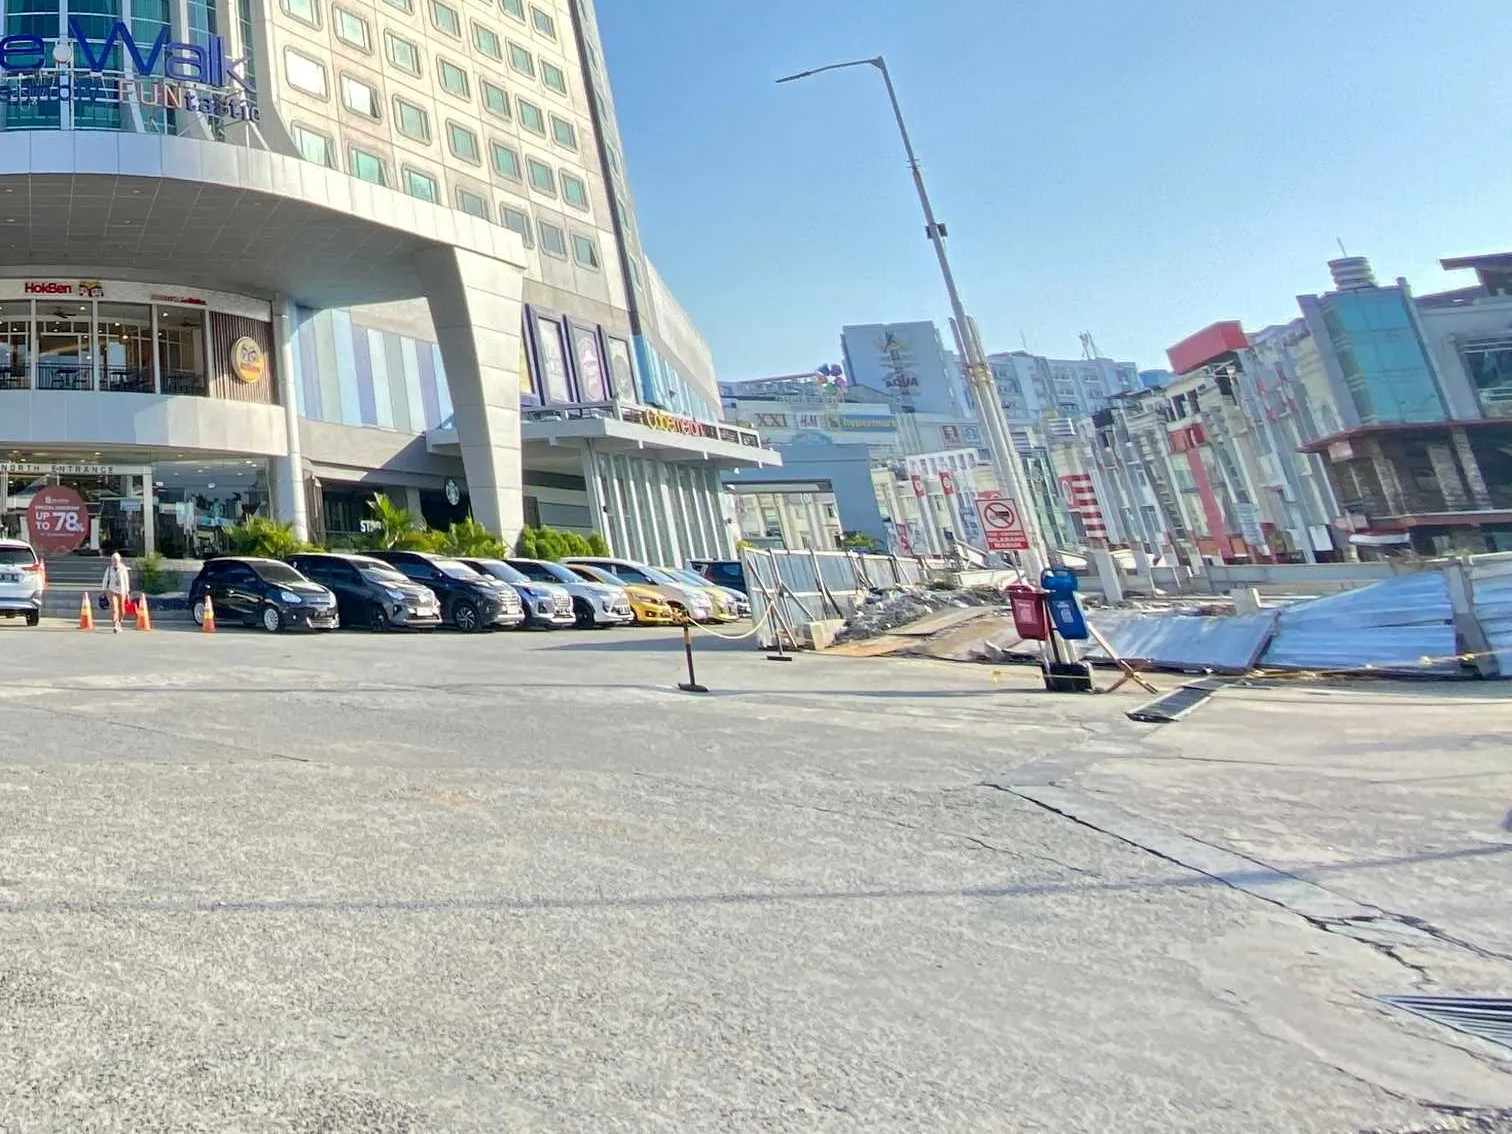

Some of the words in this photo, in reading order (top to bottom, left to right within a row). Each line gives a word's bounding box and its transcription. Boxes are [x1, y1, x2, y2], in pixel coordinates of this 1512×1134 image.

[25, 282, 72, 294] HokBen
[886, 374, 919, 389] AQUA
[756, 413, 788, 427] XXI
[1, 464, 40, 472] NORTH
[52, 464, 114, 475] ENTRANCE
[35, 512, 50, 521] UP
[35, 521, 50, 531] TO
